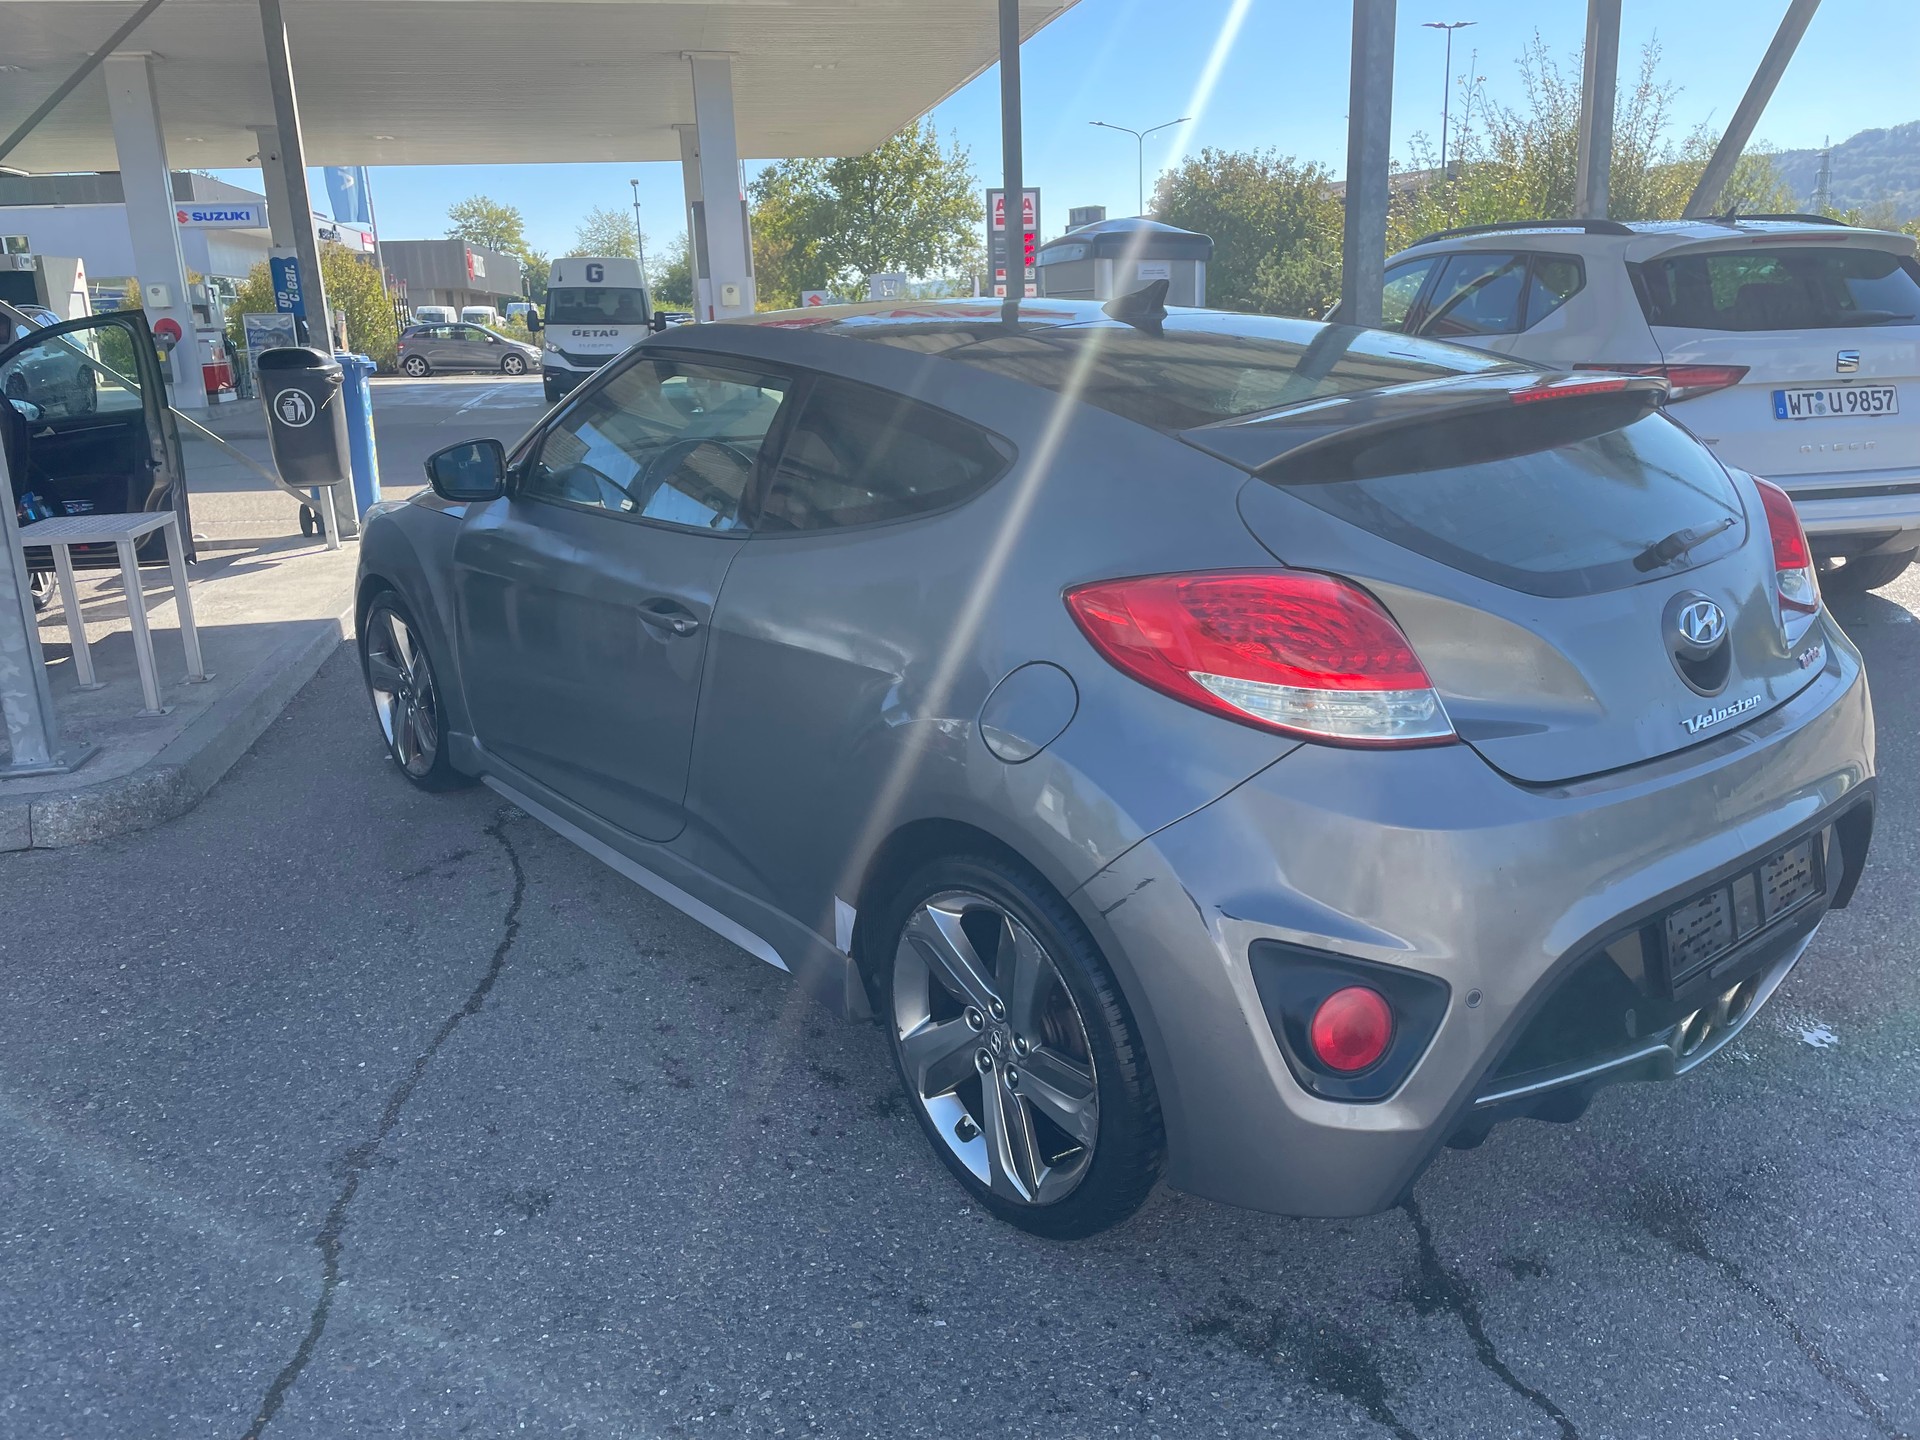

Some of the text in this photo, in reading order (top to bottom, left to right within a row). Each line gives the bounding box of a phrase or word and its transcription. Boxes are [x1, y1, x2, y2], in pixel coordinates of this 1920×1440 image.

[192, 211, 250, 221] SUZUKI
[586, 263, 604, 282] G
[277, 291, 293, 308] go
[571, 329, 619, 337] GETAG
[1788, 393, 1815, 415] WT
[1846, 389, 1894, 412] 9857
[1681, 694, 1762, 734] Veloster
